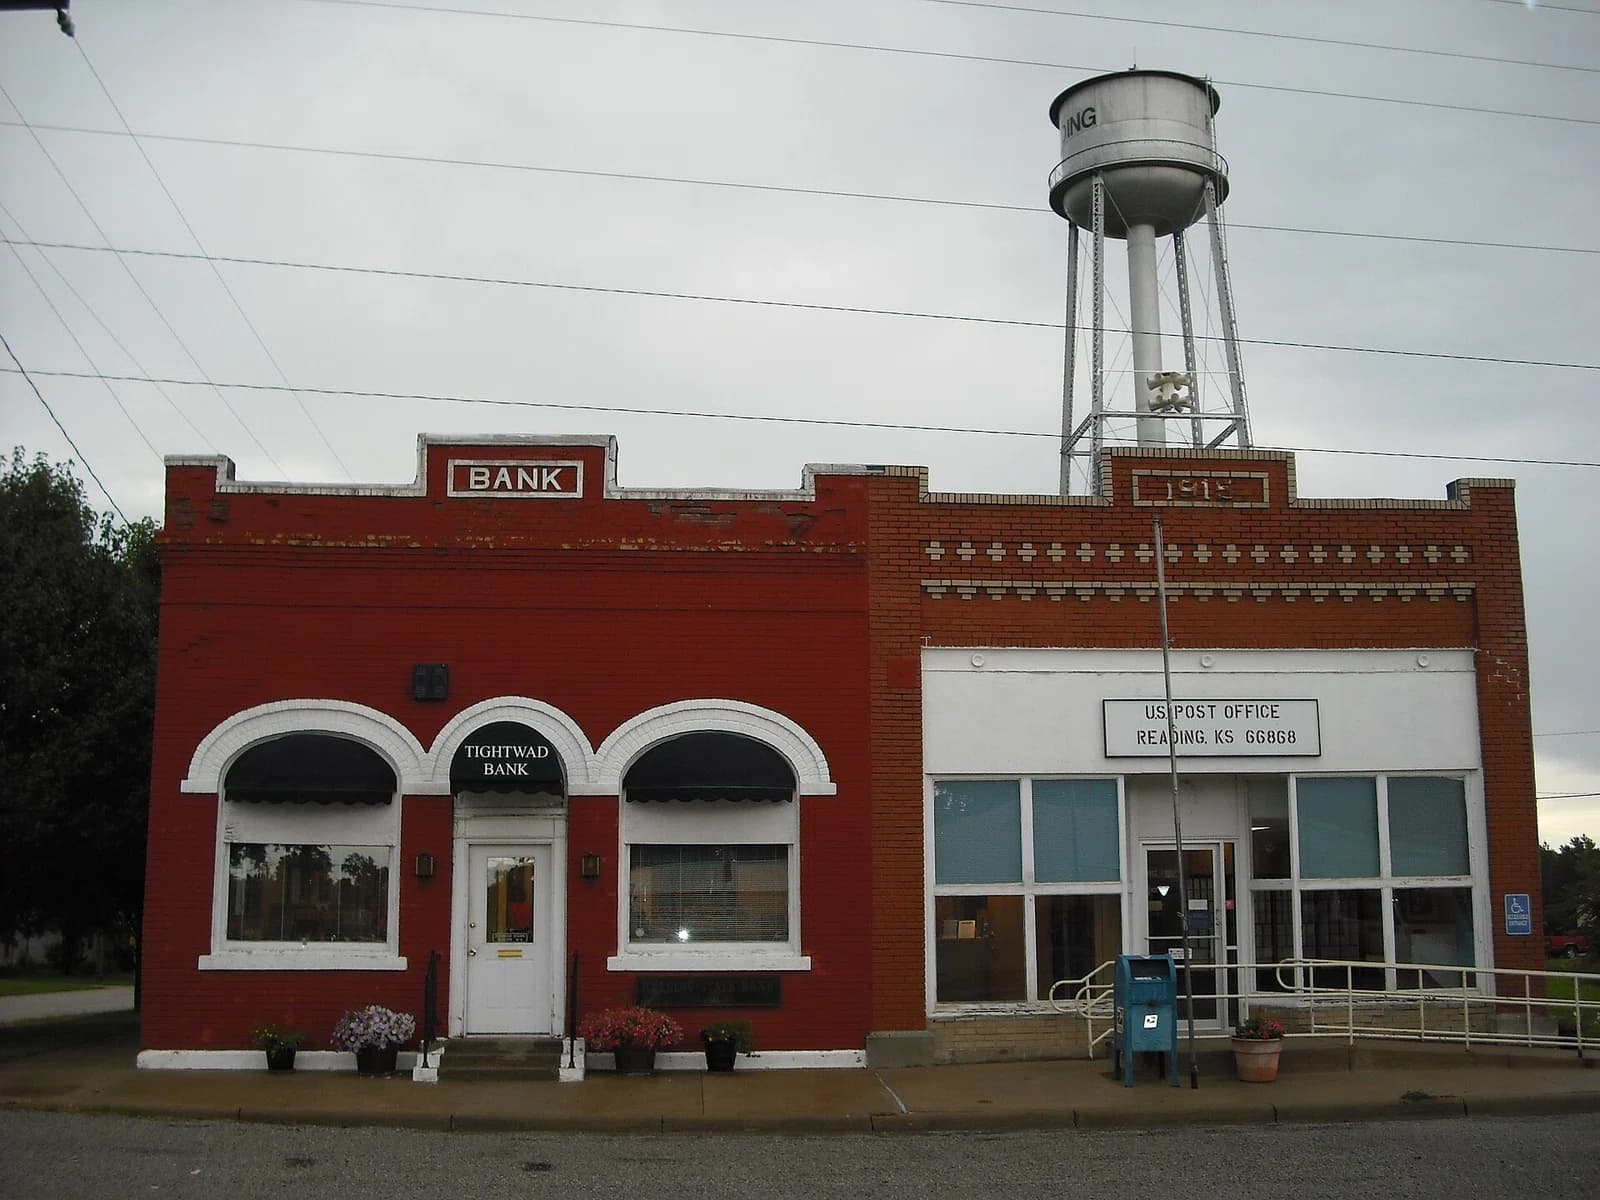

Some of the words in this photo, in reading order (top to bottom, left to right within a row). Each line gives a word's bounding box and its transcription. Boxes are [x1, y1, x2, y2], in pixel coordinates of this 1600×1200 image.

[469, 467, 563, 491] BANK
[1174, 704, 1217, 720] POST
[1224, 704, 1280, 719] OFFICE
[1214, 729, 1234, 745] KS
[1245, 729, 1297, 744] 66868
[464, 745, 549, 758] TIGHTWAD
[484, 762, 529, 776] BANK
